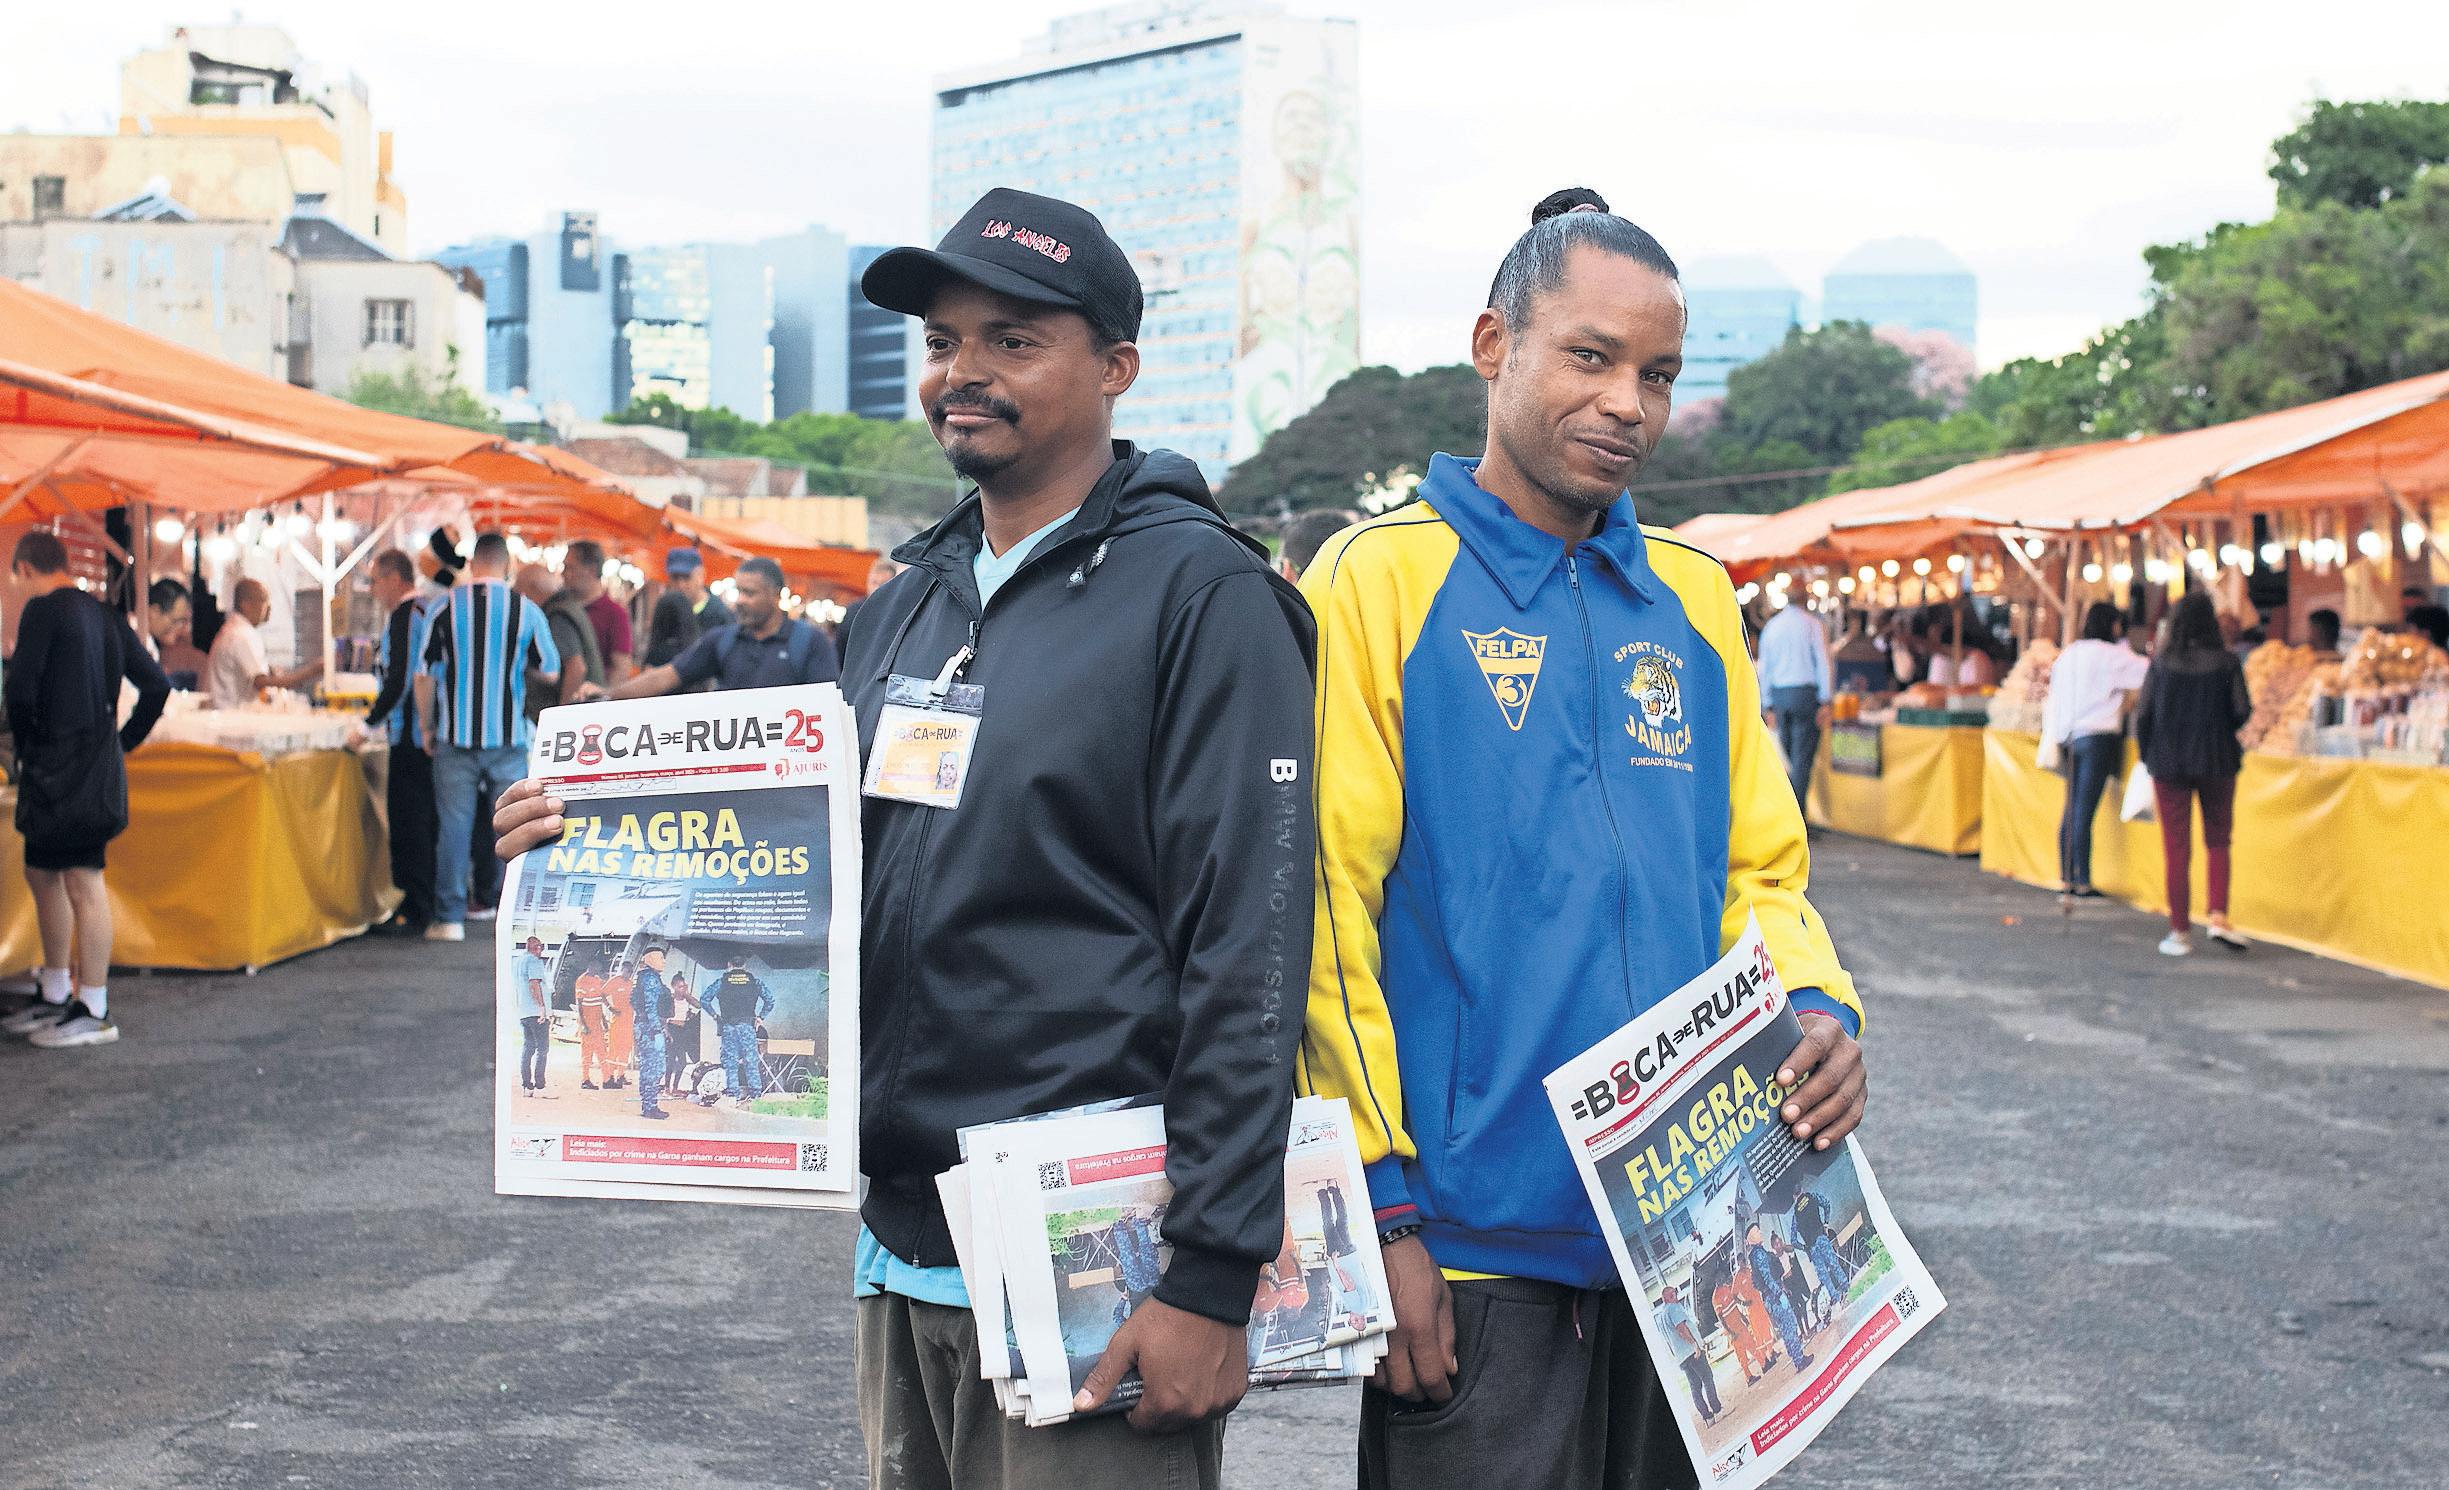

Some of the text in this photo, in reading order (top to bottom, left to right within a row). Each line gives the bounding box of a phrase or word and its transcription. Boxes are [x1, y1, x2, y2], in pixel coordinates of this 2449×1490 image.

[981, 219, 1072, 263] LOS ANGELES
[1476, 639, 1541, 658] FELPA
[1614, 641, 1684, 670] SPORT CLUB
[686, 717, 766, 752] RUA
[1625, 714, 1692, 757] JAMAICA
[1631, 757, 1664, 766] FUNDADO
[555, 808, 745, 852] FLAGRA
[547, 840, 810, 886] NAS REMOÇÕES
[1623, 1063, 1758, 1199] FLAGRA
[1637, 1165, 1695, 1226] NAS
